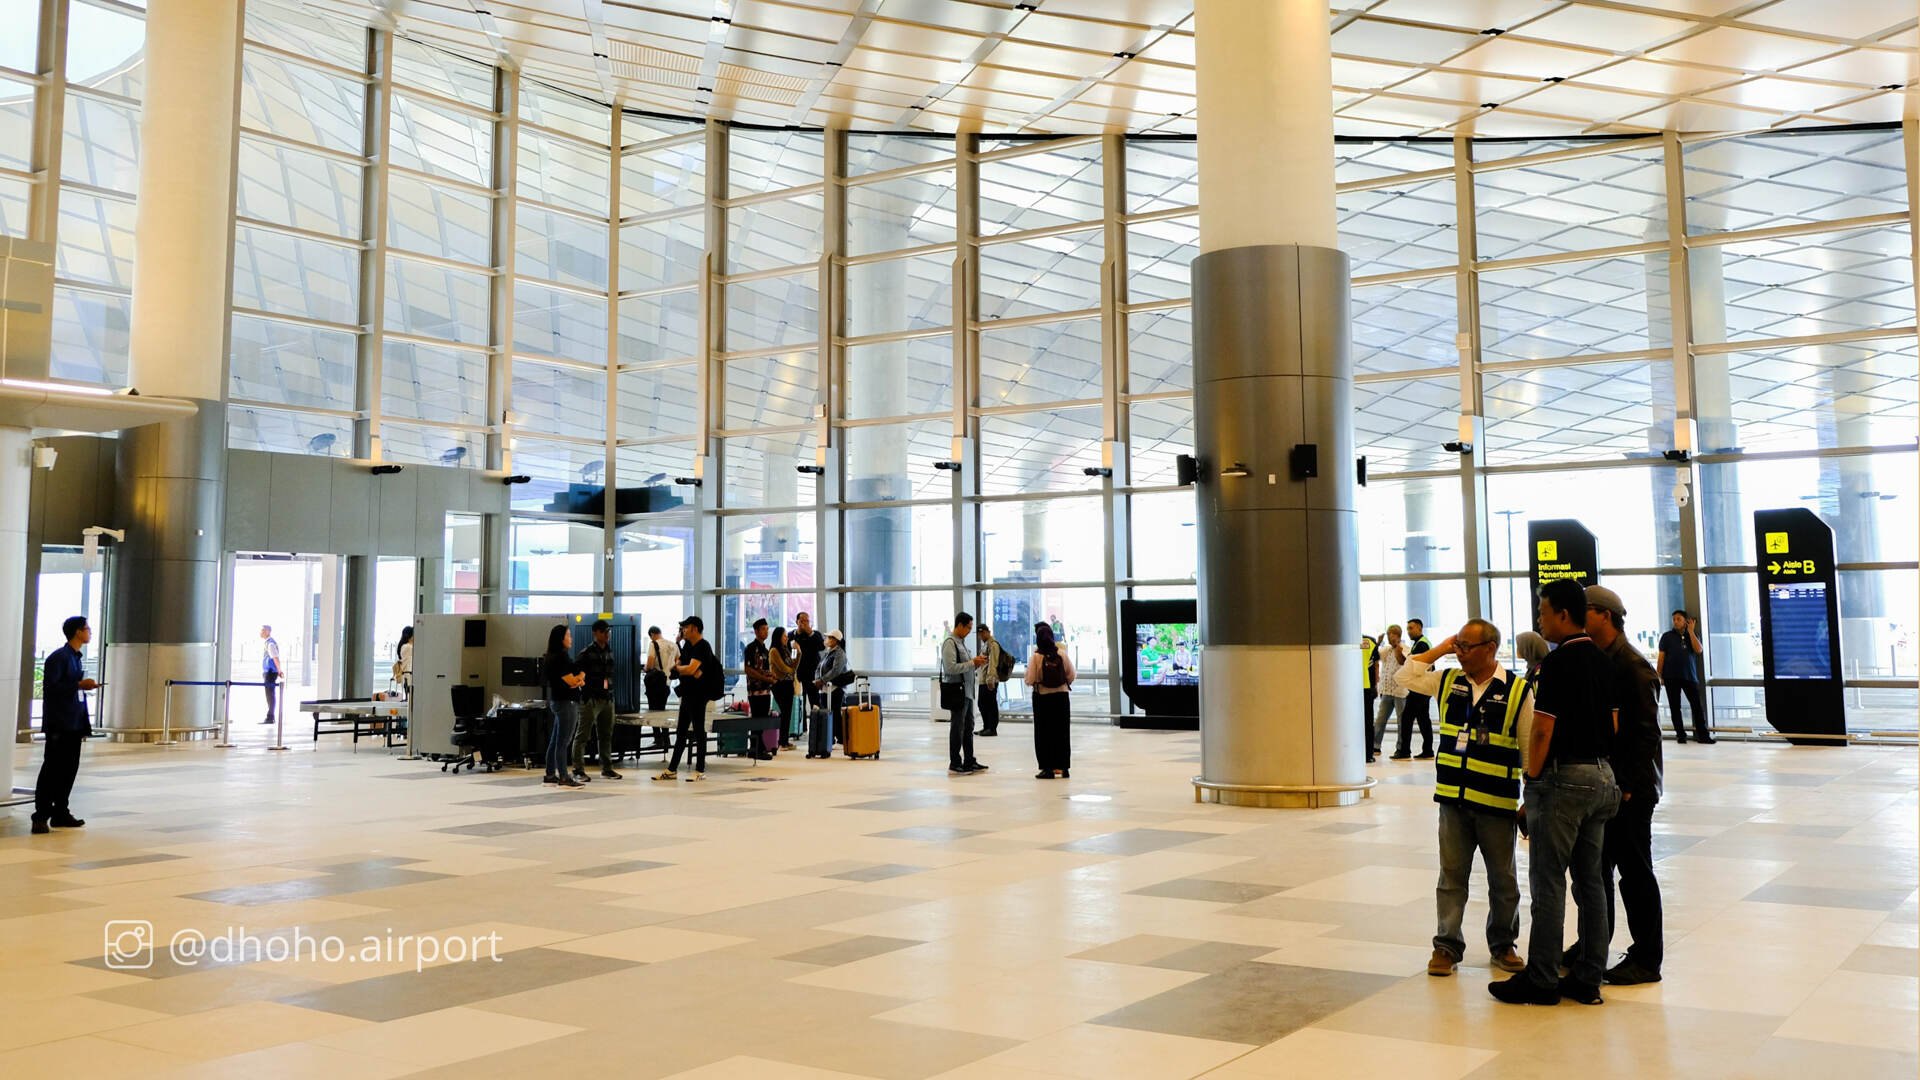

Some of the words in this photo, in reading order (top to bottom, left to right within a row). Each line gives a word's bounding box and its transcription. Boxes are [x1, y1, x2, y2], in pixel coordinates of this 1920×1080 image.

[1538, 563, 1571, 571] Informasi
[1803, 560, 1815, 574] B
[1538, 571, 1587, 581] Penerbangan
